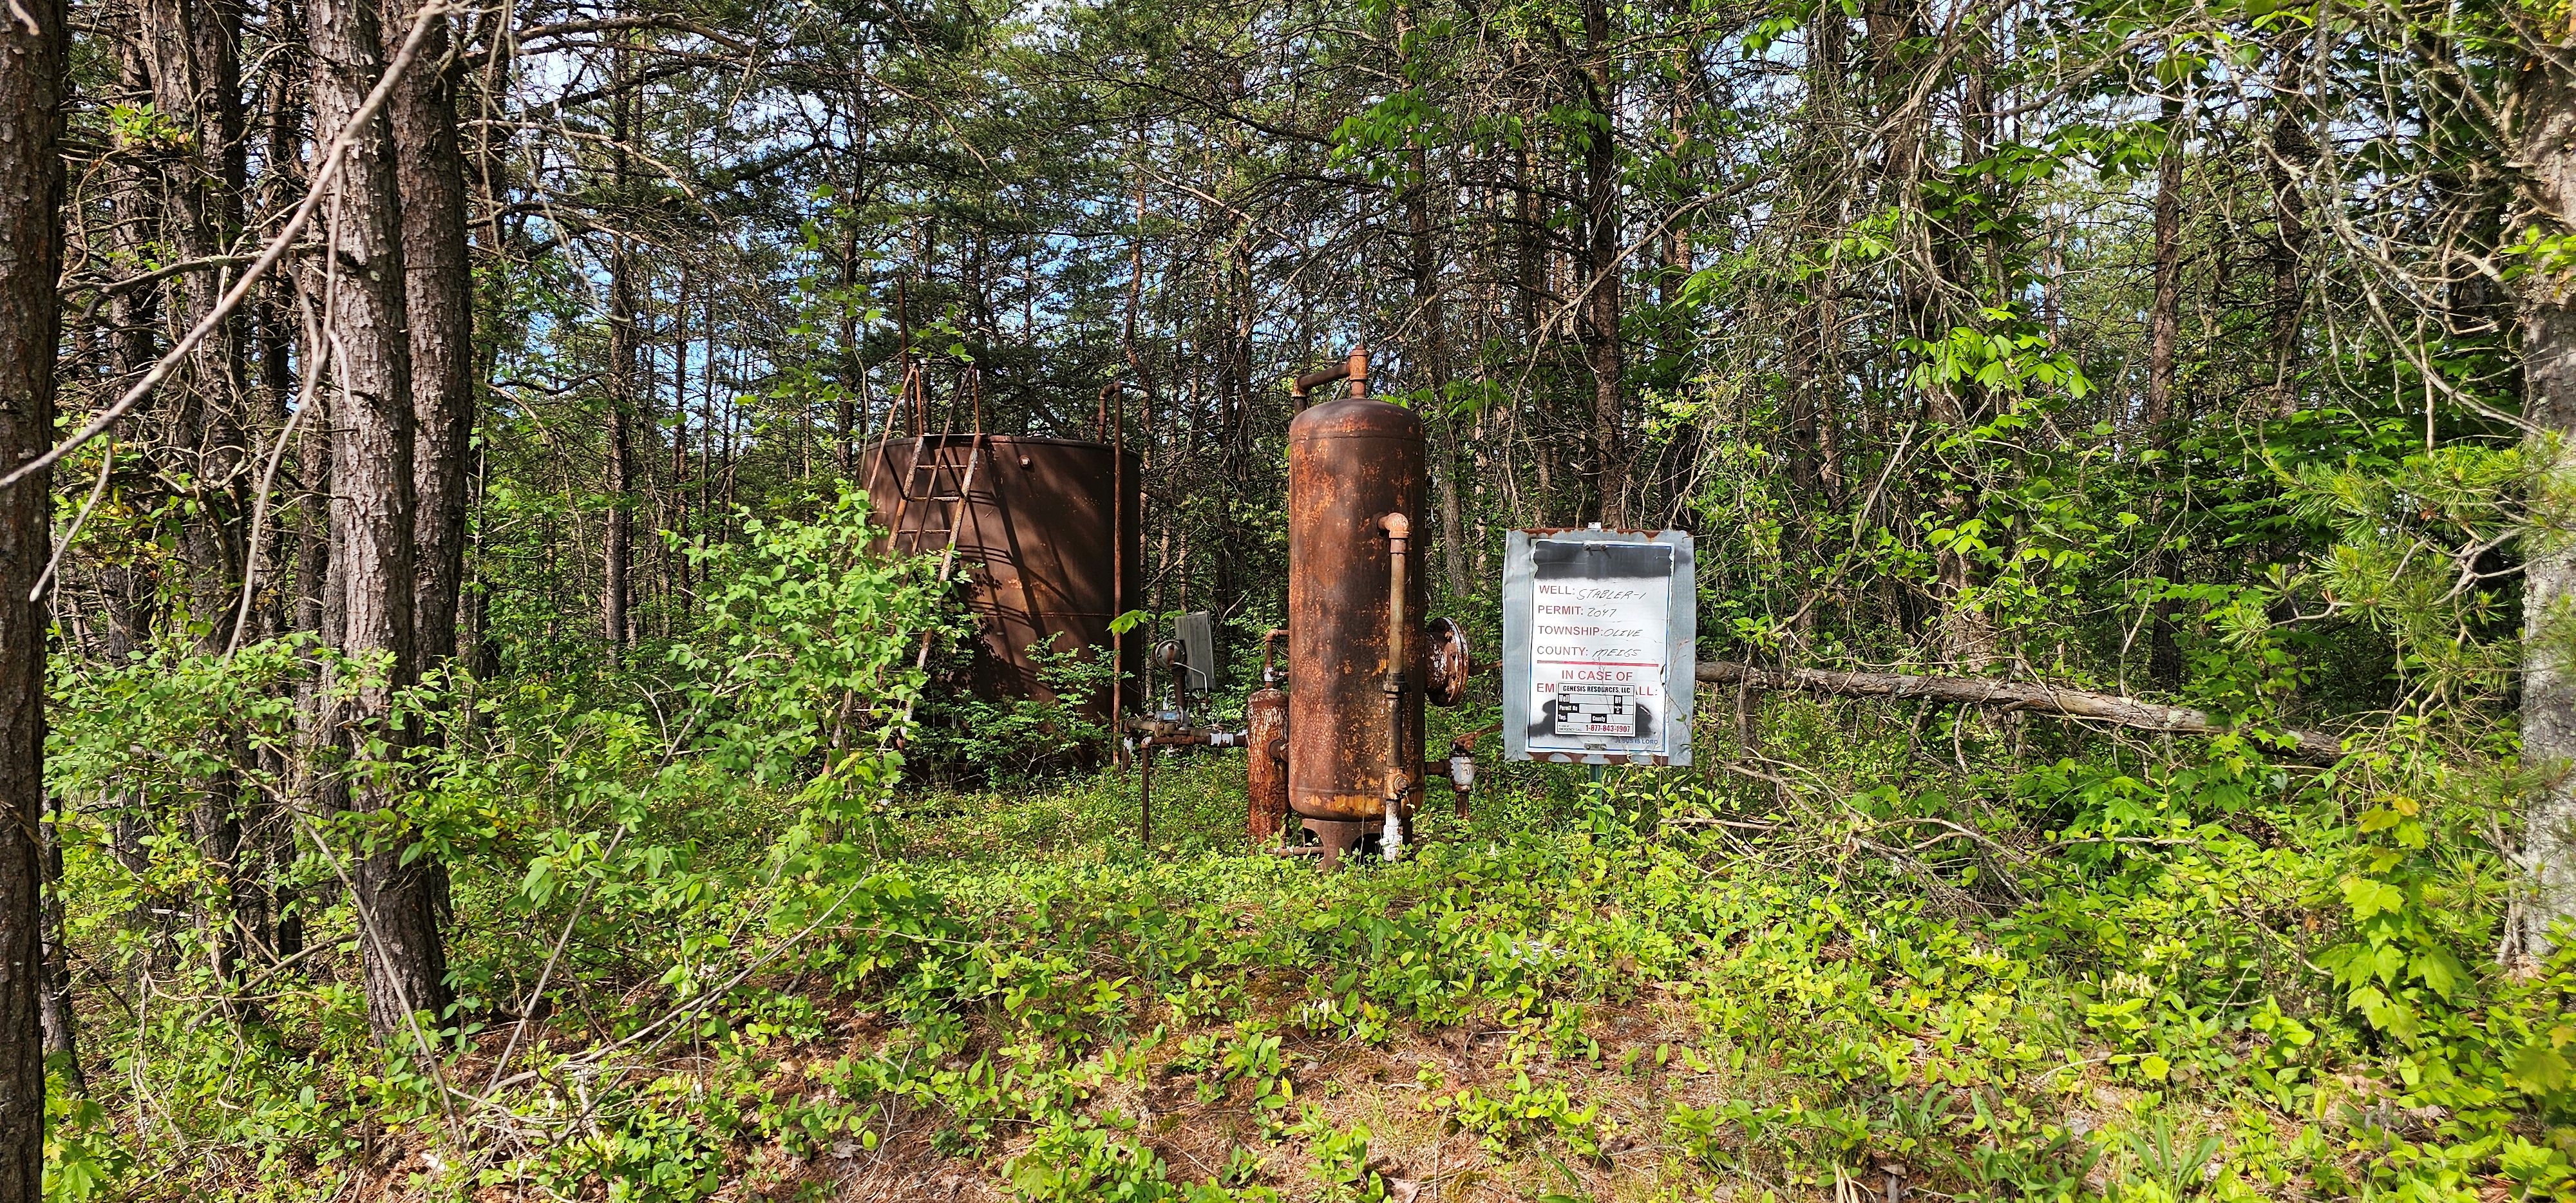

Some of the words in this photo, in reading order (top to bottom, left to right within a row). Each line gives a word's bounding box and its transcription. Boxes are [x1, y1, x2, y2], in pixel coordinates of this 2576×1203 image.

[1539, 585, 1575, 594] WELL:
[1538, 605, 1583, 615] PERMIT:
[1587, 608, 1616, 617] 2047
[1538, 626, 1603, 636] TOWNSHIP:
[1604, 629, 1643, 637] OLIVE
[1537, 646, 1588, 656] COUNTY:
[1562, 670, 1573, 679] IN
[1578, 671, 1613, 681] CASE
[1616, 672, 1633, 681] OF
